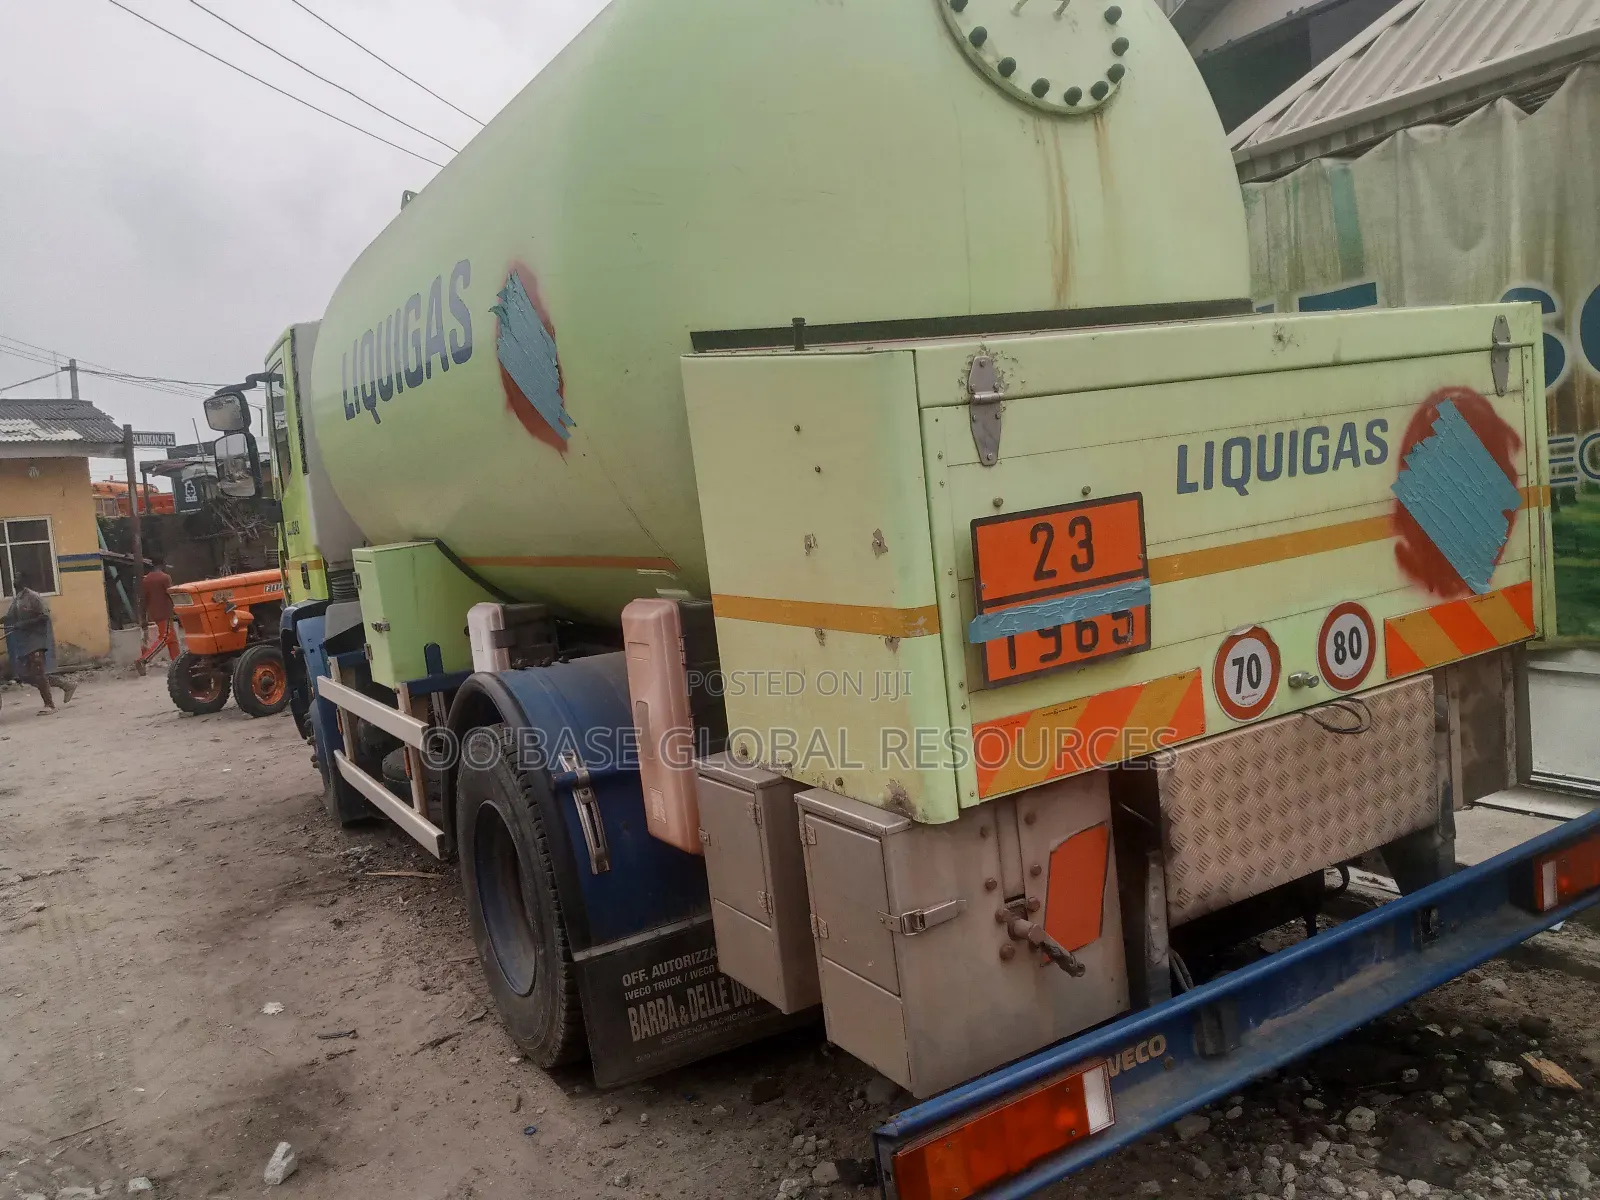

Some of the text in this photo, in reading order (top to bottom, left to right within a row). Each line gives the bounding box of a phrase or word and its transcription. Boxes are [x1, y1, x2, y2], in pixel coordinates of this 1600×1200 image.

[342, 258, 473, 424] LIQUIGAS
[1177, 418, 1389, 496] LIQUIGAS
[1030, 515, 1095, 582] 23
[1333, 626, 1362, 665] 80
[1232, 653, 1262, 694] 70
[622, 968, 649, 988] OFF.
[624, 986, 651, 1001] IVECO
[653, 976, 683, 992] TRUCK
[690, 964, 716, 980] IVECO
[627, 994, 682, 1043] BARBA
[686, 976, 731, 1022] DELLE
[1106, 1034, 1167, 1078] VECO
